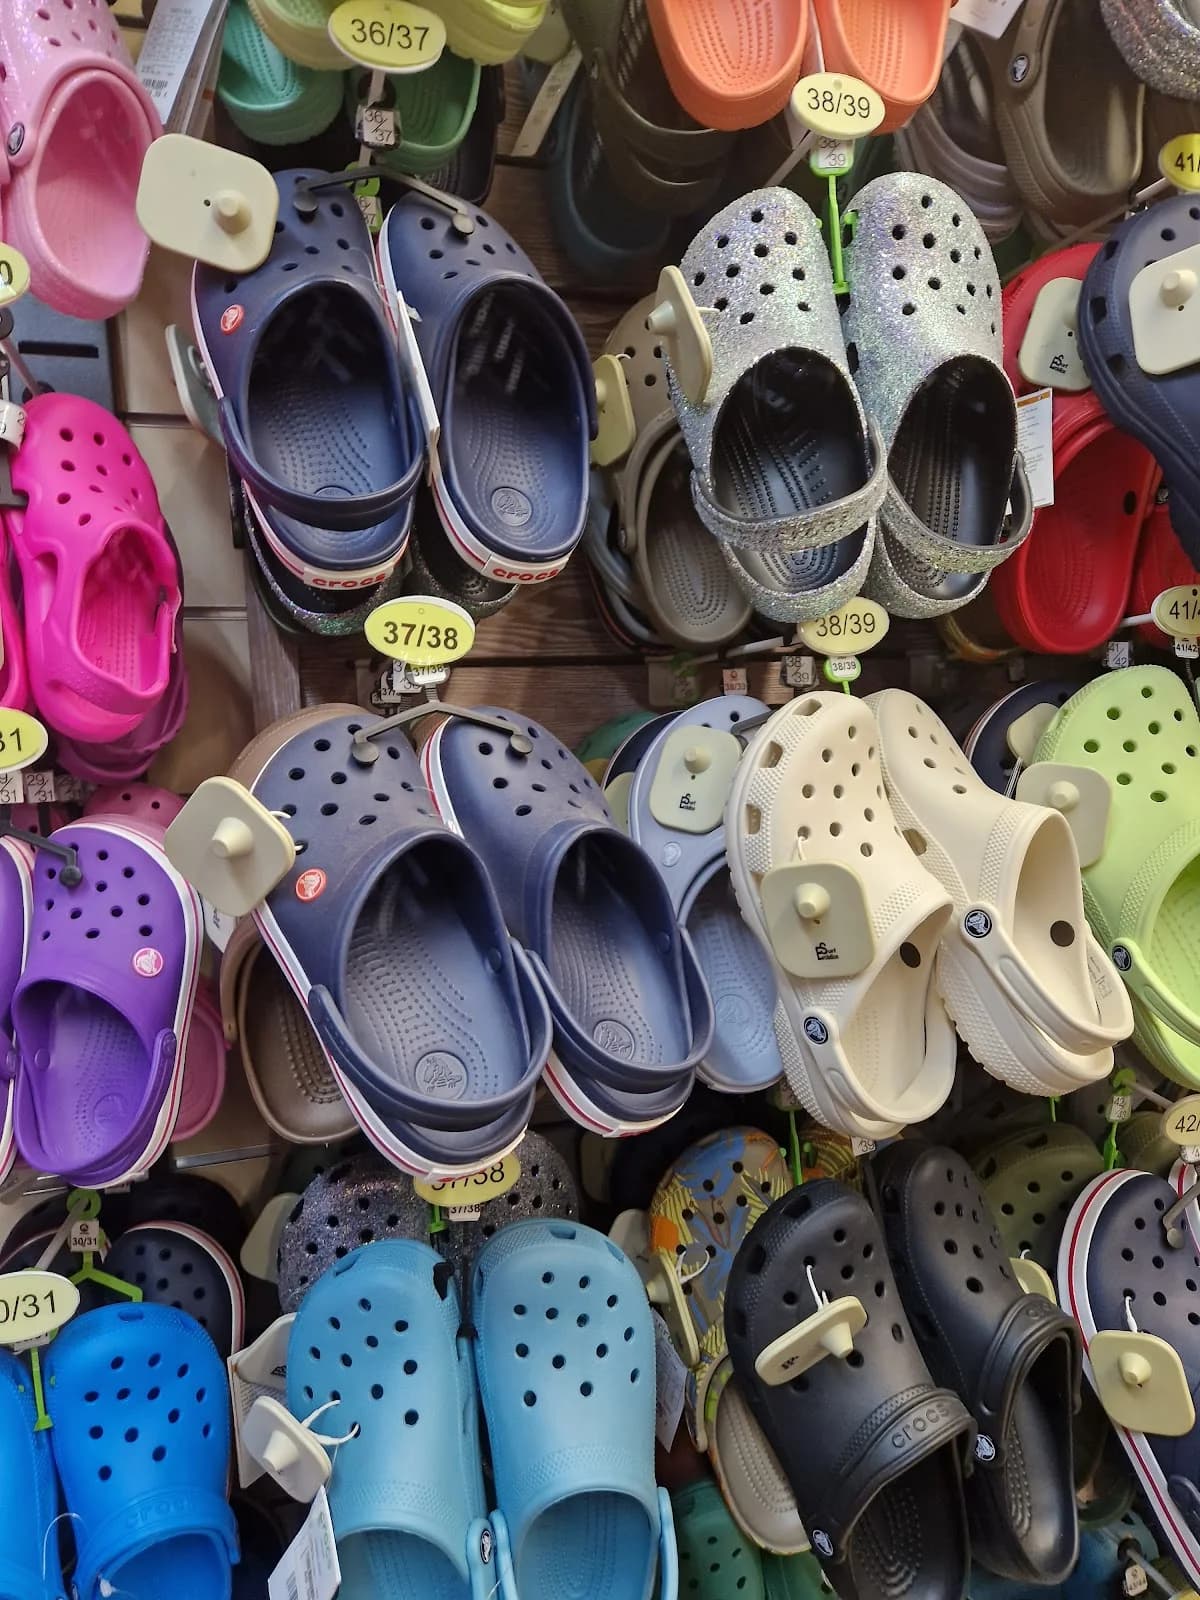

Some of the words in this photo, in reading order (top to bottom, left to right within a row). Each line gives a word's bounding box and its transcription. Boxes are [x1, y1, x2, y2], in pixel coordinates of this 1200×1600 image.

[351, 19, 430, 51] 36/37
[807, 87, 870, 118] 38/39
[312, 572, 386, 588] crocs
[492, 568, 560, 581] crocs
[1169, 599, 1200, 620] 41/
[815, 612, 876, 637] 38/39
[383, 621, 459, 650] 37/38
[412, 663, 445, 676] 37/38
[832, 661, 857, 672] 38/39
[72, 1236, 98, 1247] 30/31
[891, 1402, 950, 1449] crocs
